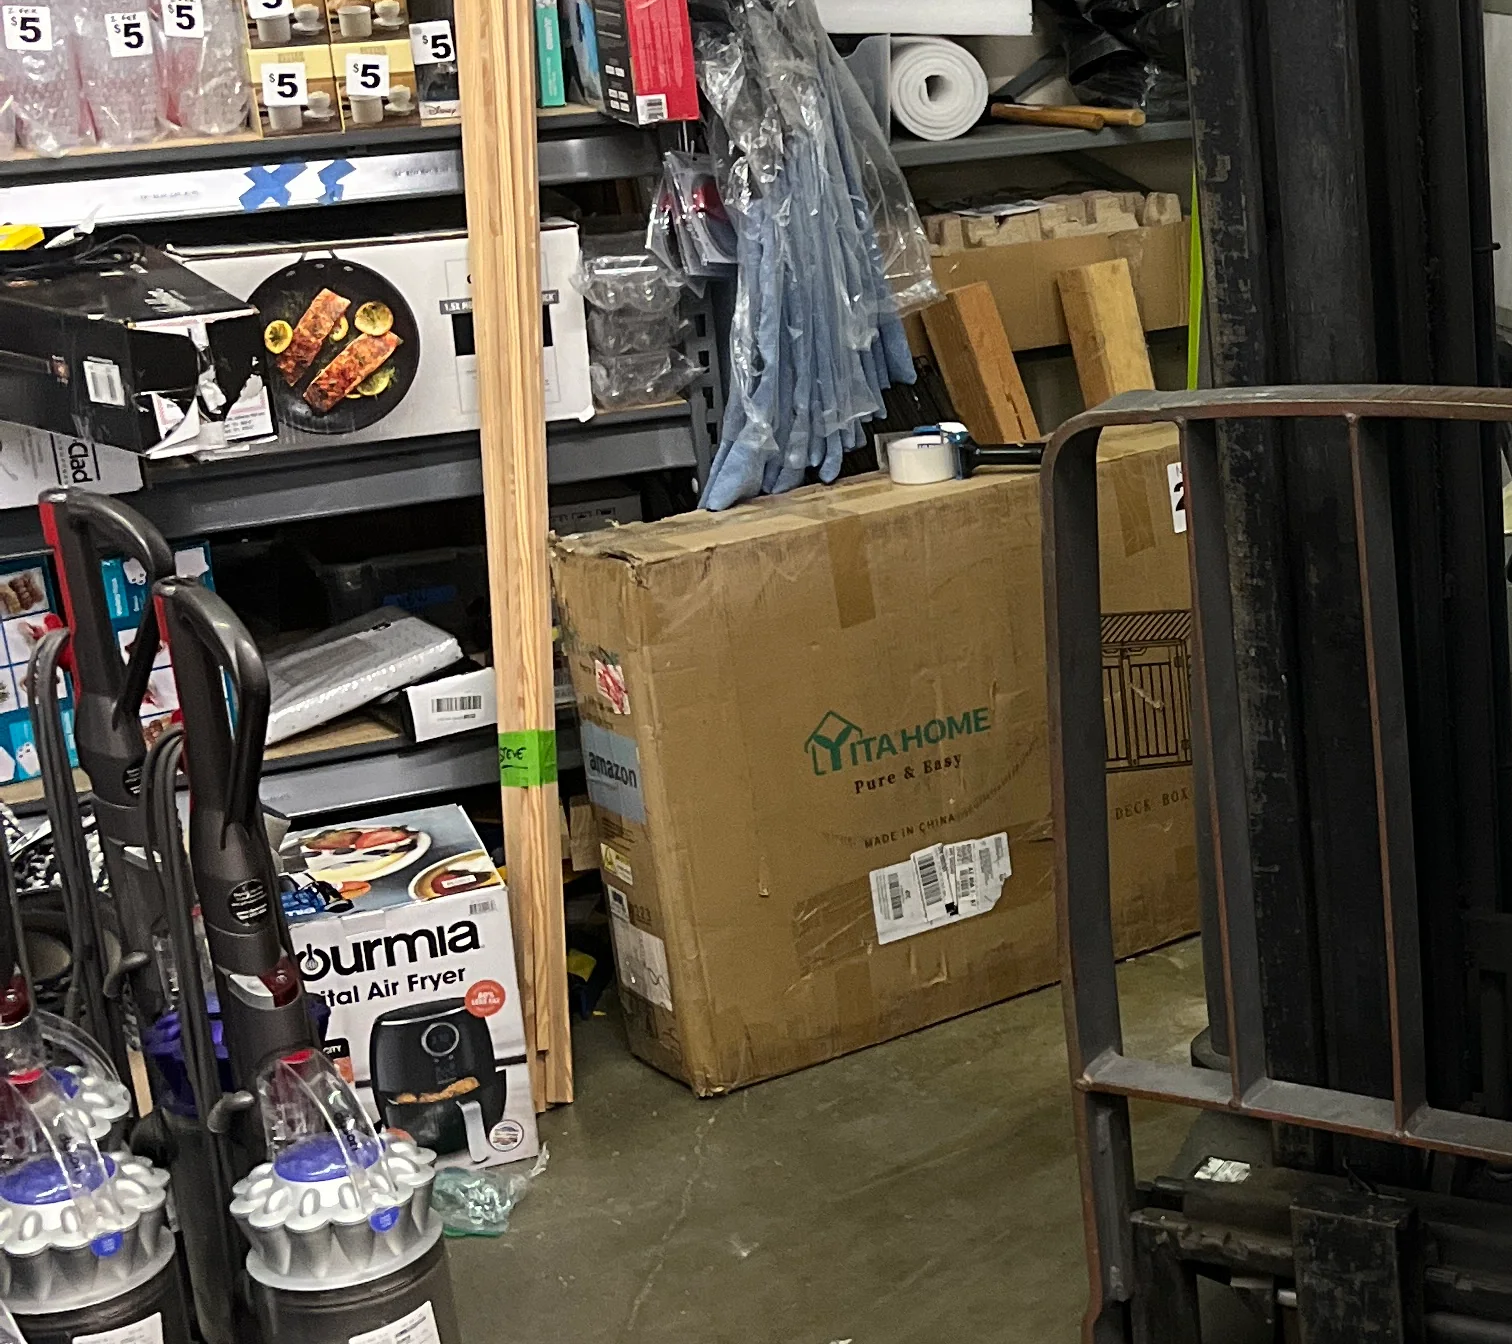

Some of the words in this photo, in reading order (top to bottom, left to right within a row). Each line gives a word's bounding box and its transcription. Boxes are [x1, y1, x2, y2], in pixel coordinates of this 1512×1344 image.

[10, 16, 42, 43] $5
[168, 4, 196, 31] $5
[113, 22, 144, 49] $5
[421, 33, 452, 60] $5
[268, 72, 299, 99] $5
[352, 63, 382, 90] $5
[427, 105, 457, 117] Disney
[589, 750, 638, 789] amazon
[854, 769, 897, 795] Pure
[903, 765, 916, 780] &
[923, 753, 963, 775] Easy
[1114, 799, 1151, 821] DECK
[1161, 788, 1191, 808] BOX
[864, 832, 897, 849] MADE
[902, 825, 914, 838] IN
[919, 813, 956, 833] CHINA
[297, 920, 481, 982] ourmia
[367, 980, 400, 1001] Air
[407, 967, 466, 993] Fryer
